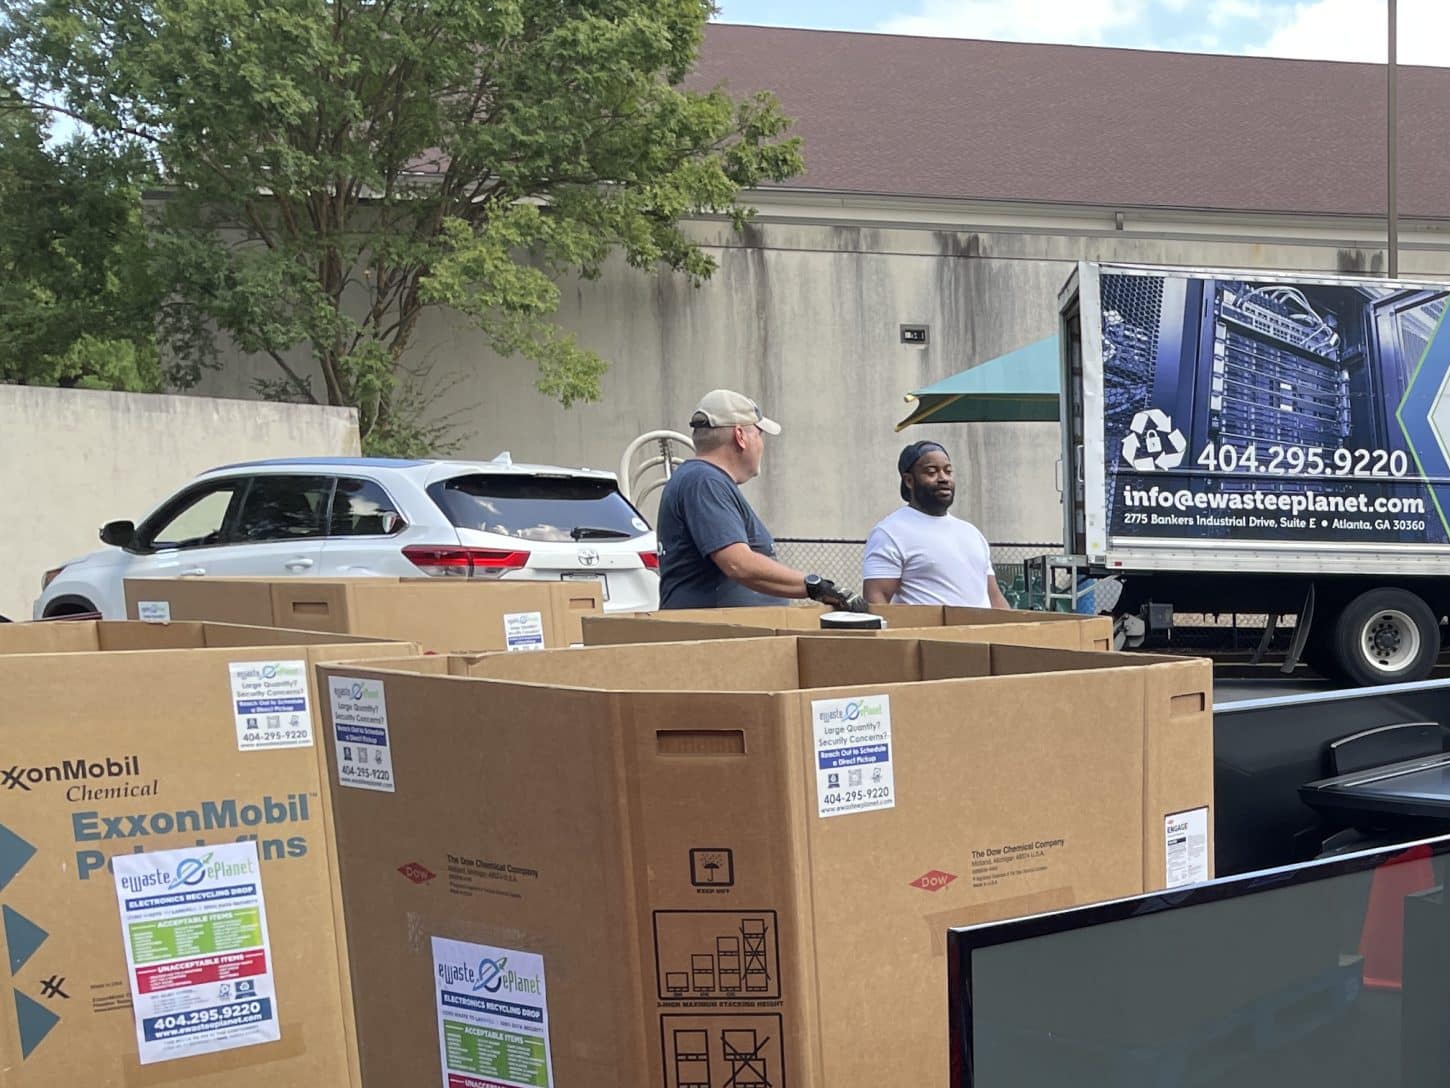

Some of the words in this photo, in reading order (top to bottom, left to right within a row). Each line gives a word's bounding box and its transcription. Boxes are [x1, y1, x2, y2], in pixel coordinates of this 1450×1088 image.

[1197, 444, 1408, 477] 404.295.9220
[1123, 485, 1425, 516] info@ewasteeplanet.com
[1123, 513, 1148, 524] 2775
[1151, 514, 1194, 526] Bankers
[1197, 515, 1246, 527] Industrial
[1249, 516, 1278, 529] Drive,
[1280, 517, 1307, 528] Suite
[1309, 518, 1316, 528] E
[1332, 519, 1373, 530] Atlanta,
[1375, 520, 1390, 530] GA
[1393, 520, 1425, 531] 30360
[243, 730, 308, 742] 404-295-9220
[818, 736, 848, 747] Security
[849, 732, 888, 744] Concerns?
[824, 726, 845, 736] Large
[847, 722, 880, 733] Quantity?
[0, 756, 140, 791] xxonMobil
[341, 765, 390, 781] 404-295-9220
[66, 780, 159, 803] Chemical
[824, 786, 889, 804] 404-295-9220
[72, 793, 310, 842] ExxonMobil
[971, 850, 985, 859] The
[986, 848, 1002, 857] Dow
[1003, 843, 1034, 854] Chemical
[1035, 839, 1065, 849] Company
[207, 858, 254, 880] ePlanet
[128, 894, 186, 909] ELECTRONICS
[187, 889, 230, 901] RECYCLING
[231, 886, 254, 896] DROP
[157, 916, 208, 929] ACCEPTABLE
[209, 912, 233, 922] ITEMS
[157, 957, 220, 973] UNACCEPTABLE
[221, 954, 245, 965] ITEMS
[503, 971, 542, 995] ePlanet
[154, 1001, 261, 1030] 404.295.9220
[444, 994, 485, 1009] ELECTRONICS
[486, 1001, 521, 1015] RECYCLING
[522, 1008, 541, 1018] DROP
[464, 1026, 503, 1041] ACCEPTABLE
[504, 1034, 524, 1044] ITEMS
